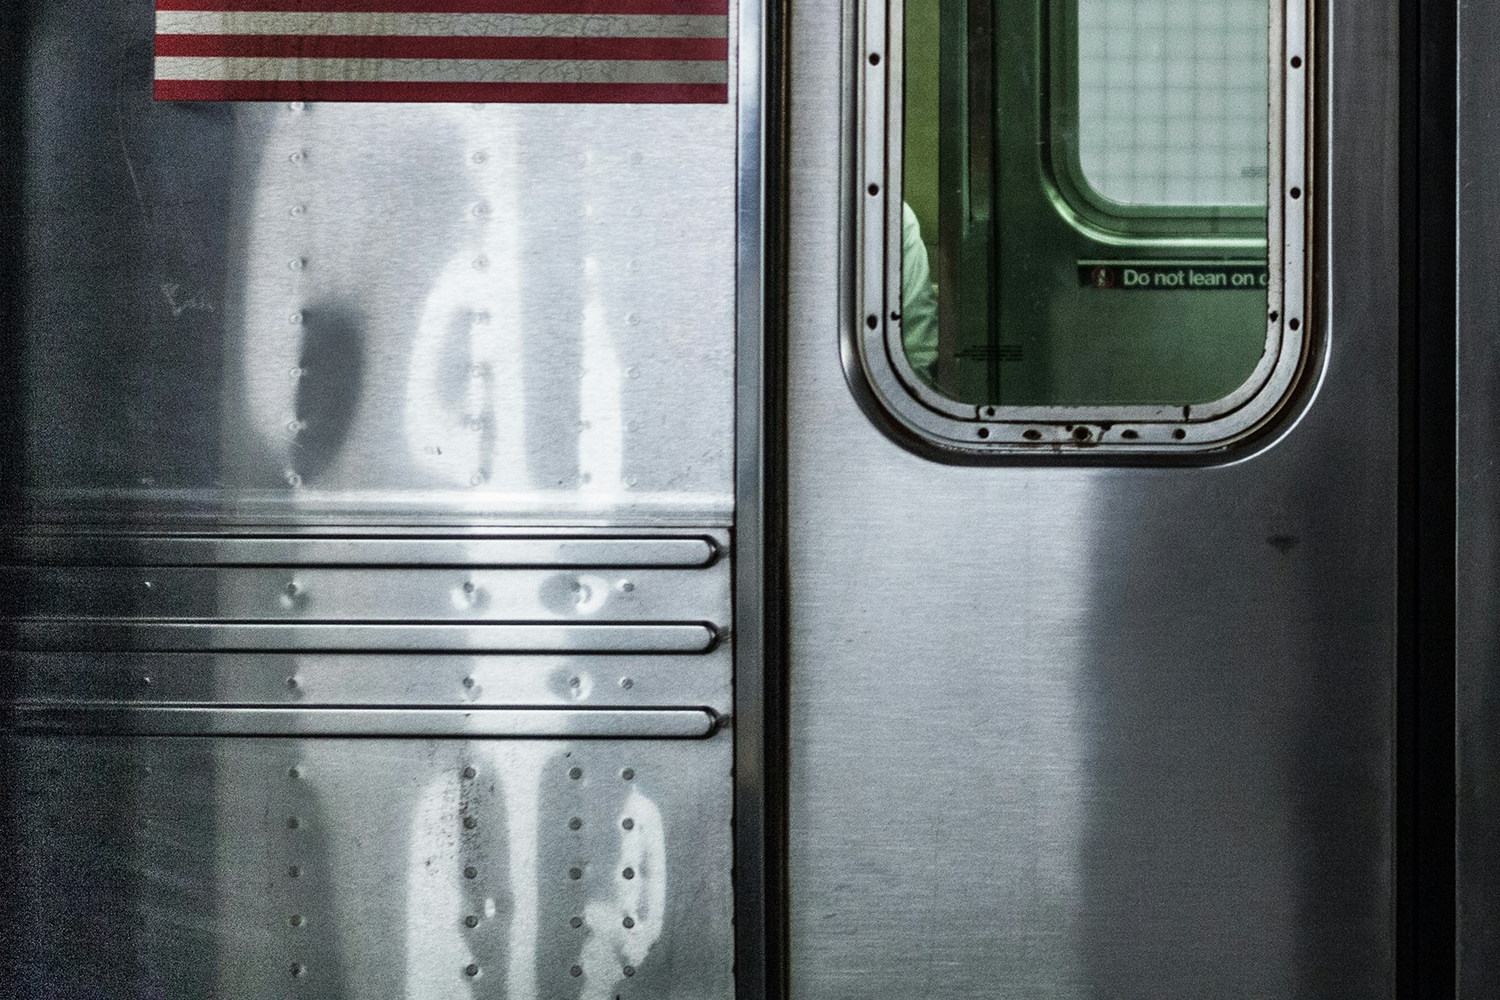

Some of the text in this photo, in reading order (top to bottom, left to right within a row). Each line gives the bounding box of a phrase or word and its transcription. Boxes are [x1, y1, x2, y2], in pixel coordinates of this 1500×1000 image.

[1123, 269, 1150, 286] Do
[1154, 270, 1185, 286] not
[1189, 269, 1227, 286] lean
[1231, 273, 1255, 286] on
